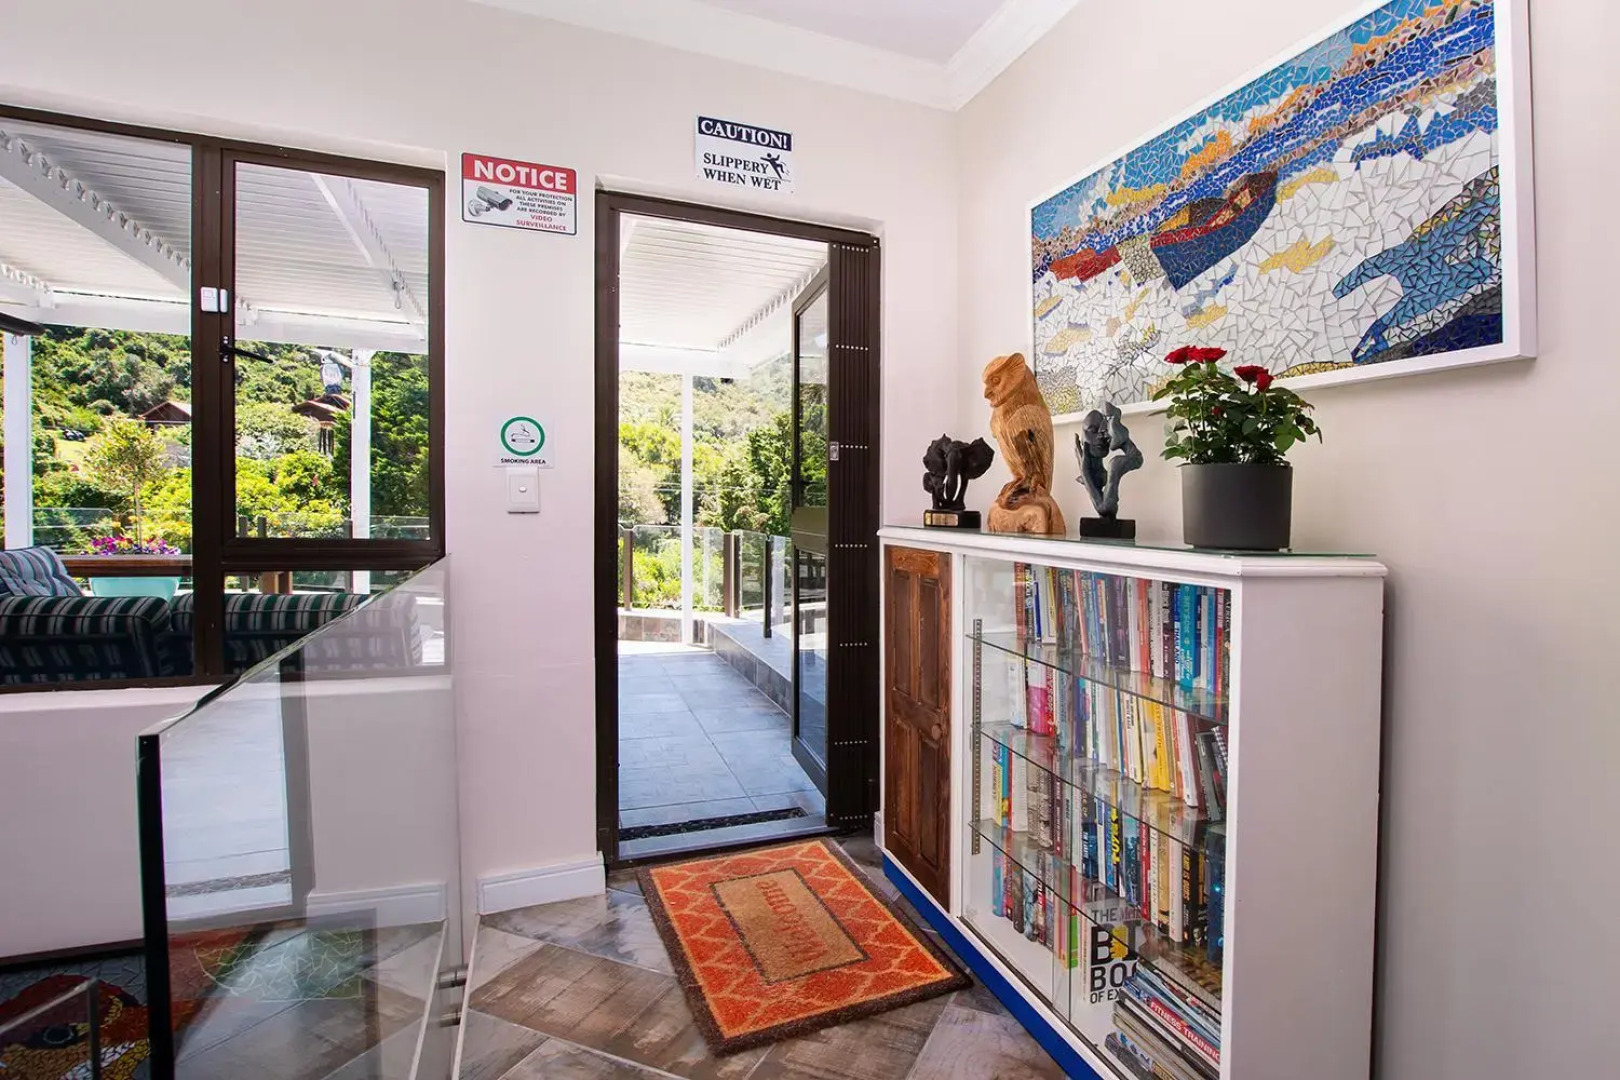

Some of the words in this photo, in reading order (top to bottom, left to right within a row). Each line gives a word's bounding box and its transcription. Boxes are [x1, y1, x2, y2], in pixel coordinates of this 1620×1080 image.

[700, 120, 787, 149] CAUTION!
[703, 152, 769, 174] SLIPPERY
[474, 160, 567, 191] NOTICE
[703, 167, 746, 185] WHEN
[750, 176, 781, 190] WET
[527, 197, 556, 206] ACTIVITIES
[539, 192, 572, 201] PROTECTION
[529, 208, 557, 216] RECORDED
[538, 203, 563, 211] PREMISES
[516, 219, 567, 231] SURVEILLANCE
[530, 214, 552, 222] VIDEO
[1091, 907, 1118, 922] THE
[1090, 990, 1106, 1004] OF
[1150, 1000, 1182, 1030] FITNESS
